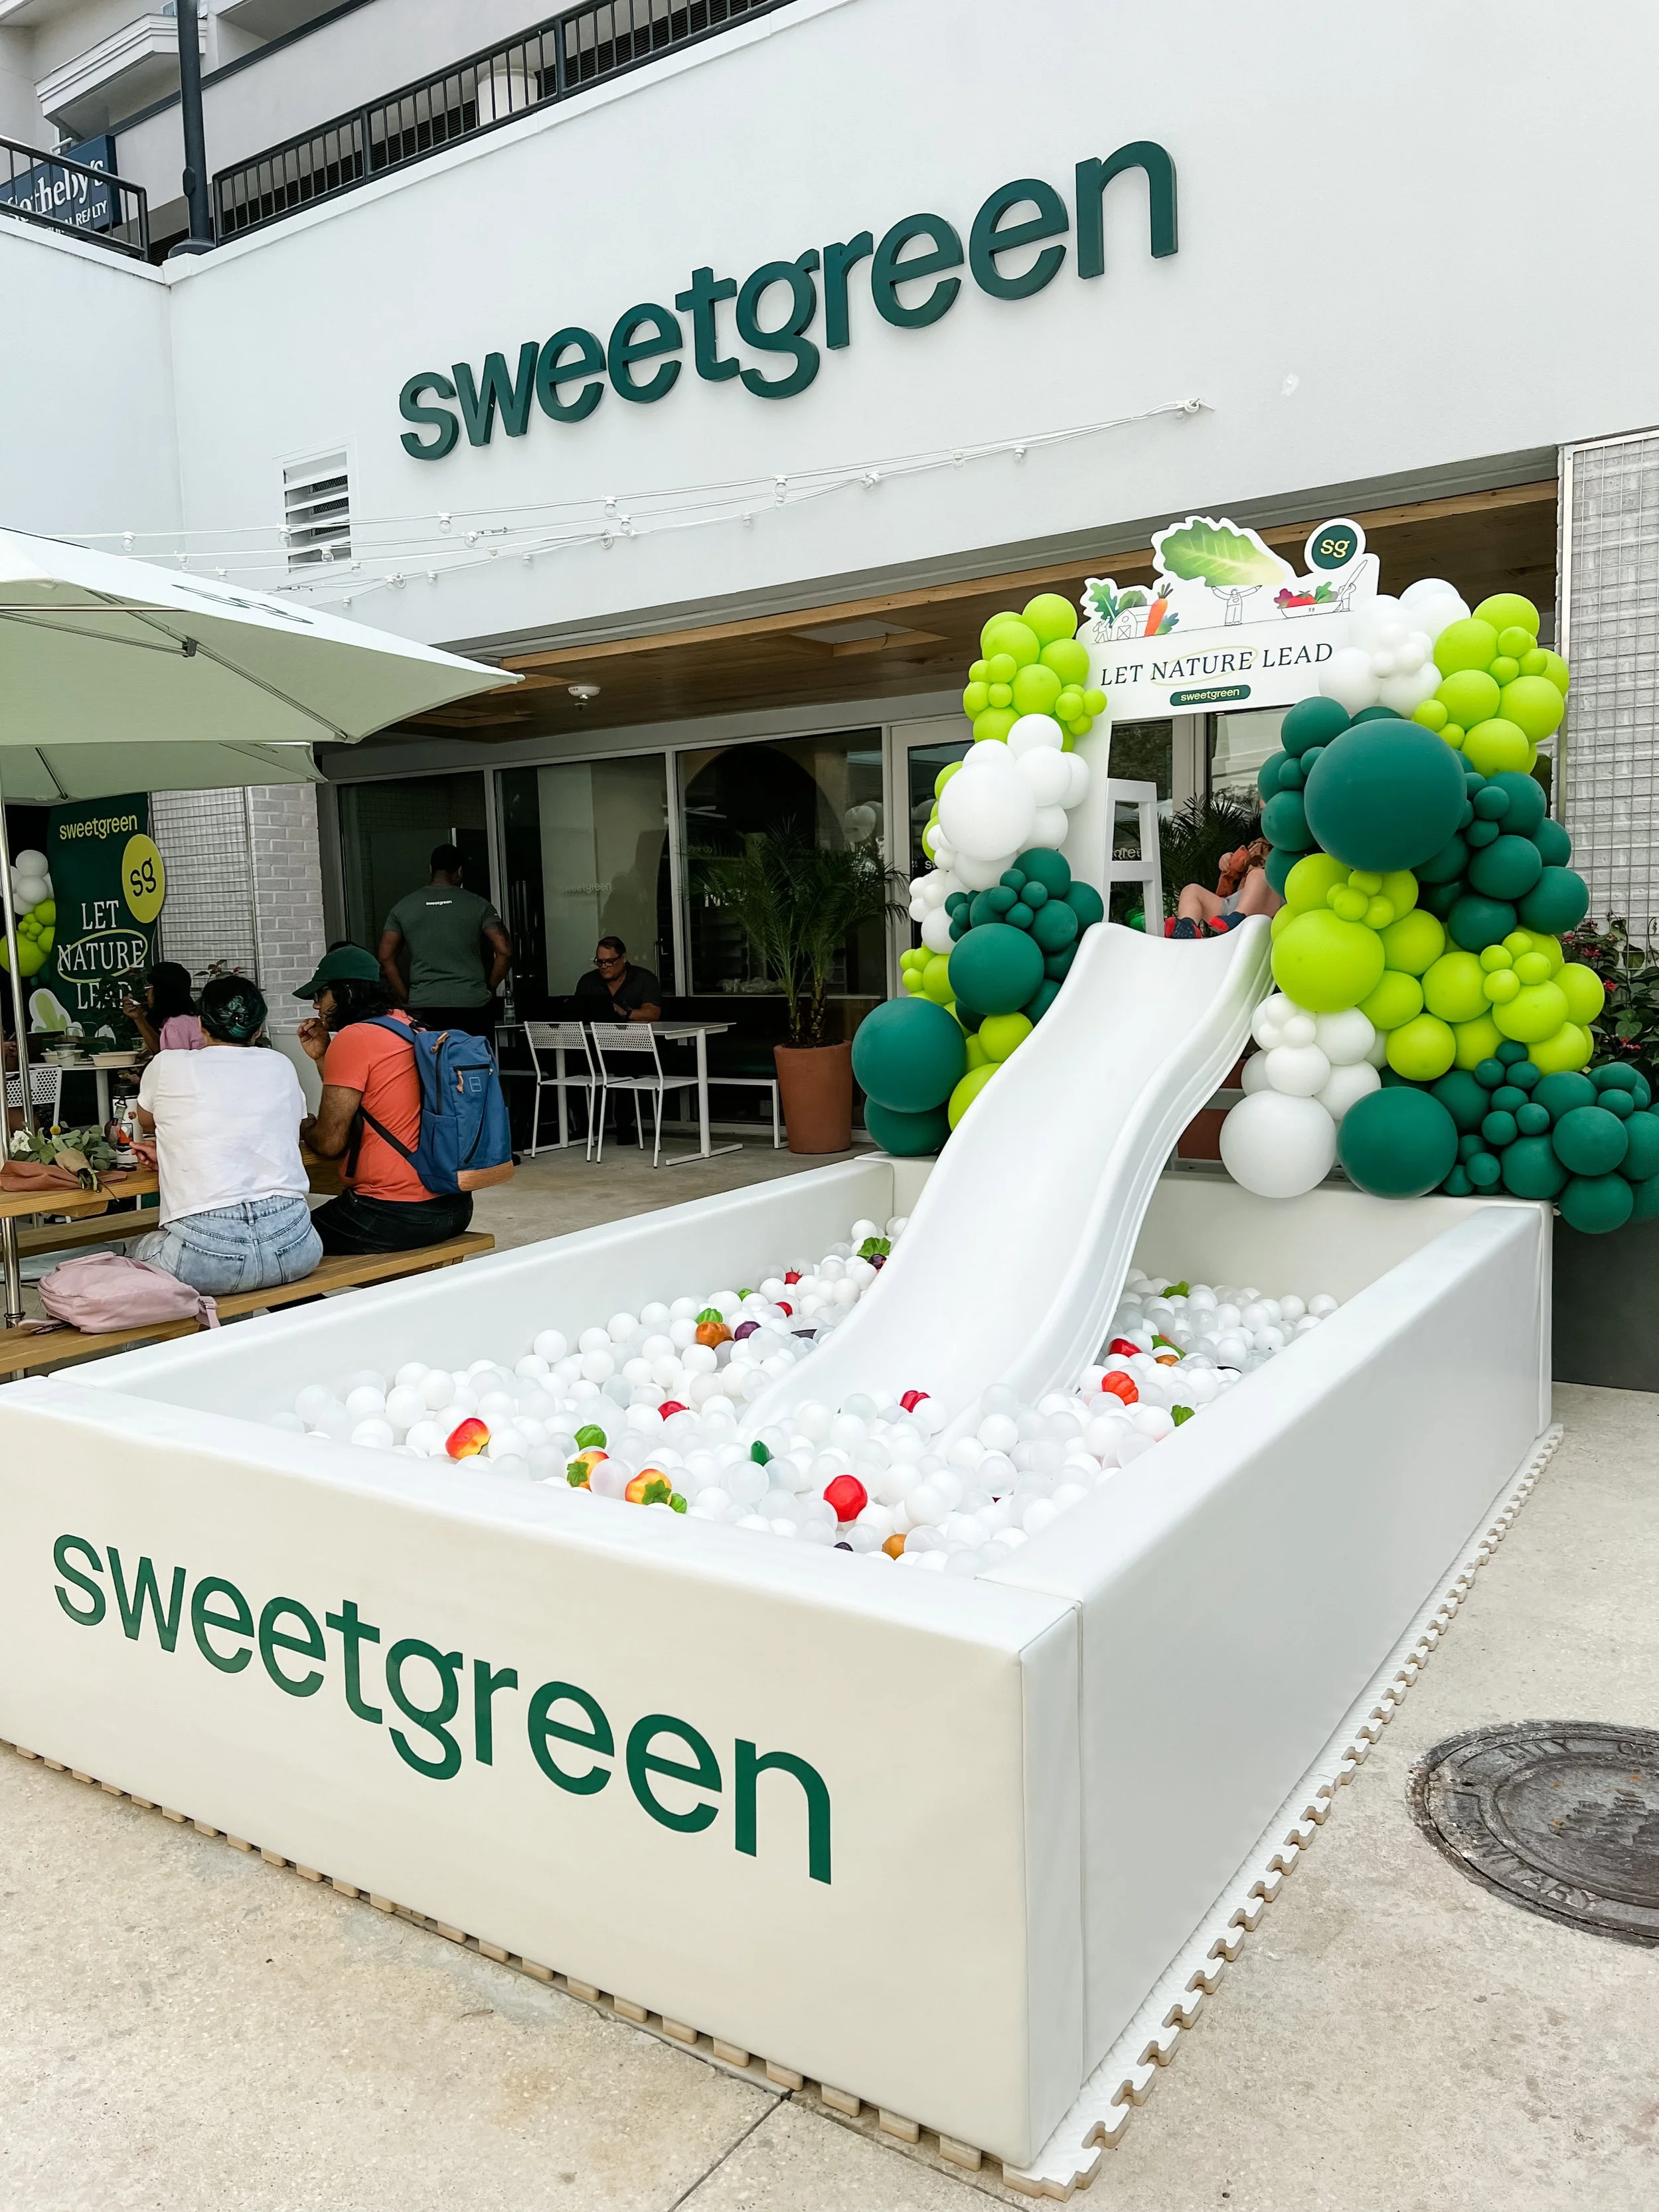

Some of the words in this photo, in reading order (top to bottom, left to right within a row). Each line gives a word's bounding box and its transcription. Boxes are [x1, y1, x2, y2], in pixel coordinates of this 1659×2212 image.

[399, 140, 1178, 462] sweetgreen
[1320, 539, 1350, 558] sg
[1100, 663, 1143, 686] LET
[1150, 651, 1253, 680] NATURE
[1262, 643, 1333, 668] LEAD
[1180, 687, 1240, 702] sweetgreen
[59, 815, 138, 840] sweetgreen
[130, 856, 157, 897] sg
[81, 900, 119, 930] LET
[57, 940, 145, 971] NATURE
[54, 1534, 832, 1885] sweetgreen
